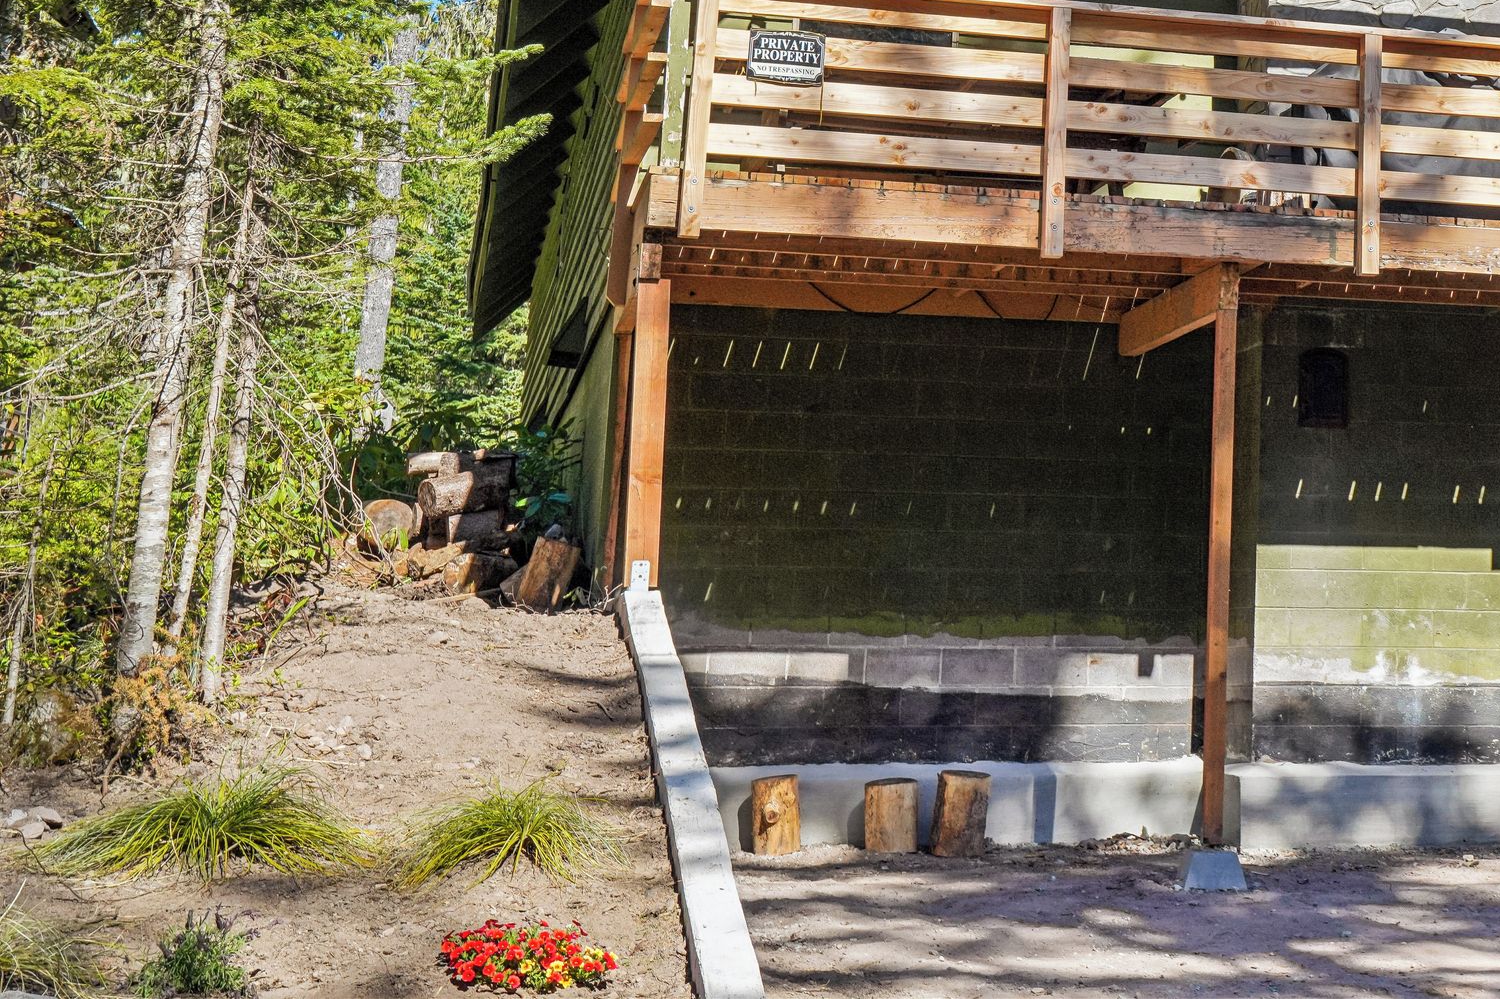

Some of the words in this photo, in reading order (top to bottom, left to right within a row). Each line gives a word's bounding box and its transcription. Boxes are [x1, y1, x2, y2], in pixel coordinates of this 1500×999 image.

[760, 37, 815, 52] PRIVATE
[753, 48, 820, 64] PROPERTY
[769, 66, 815, 76] TRESPASSING
